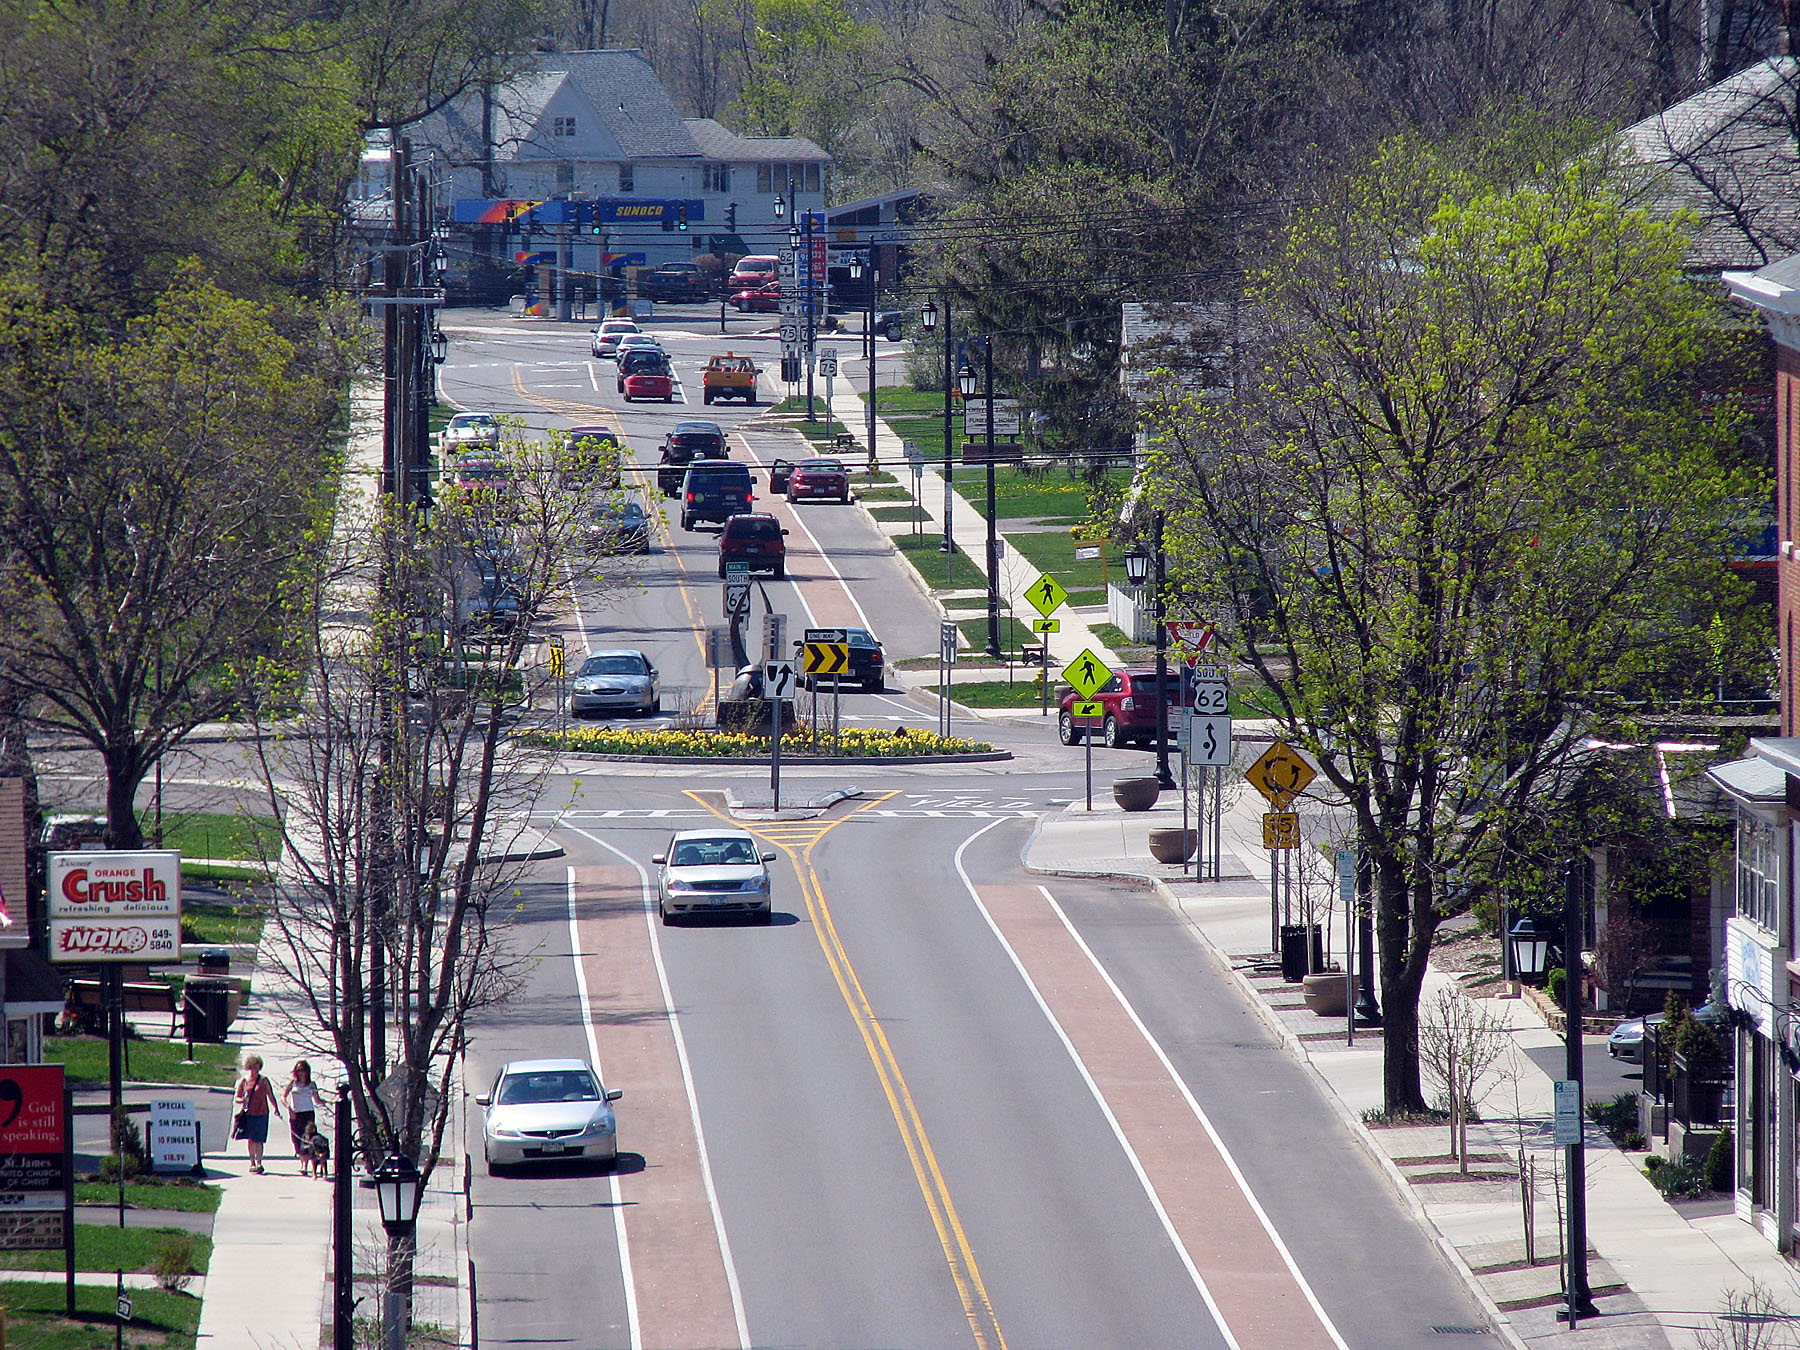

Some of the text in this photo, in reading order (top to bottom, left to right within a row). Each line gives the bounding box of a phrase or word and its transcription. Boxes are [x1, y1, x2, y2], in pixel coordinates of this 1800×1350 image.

[616, 206, 663, 216] SUNOCO
[780, 252, 792, 260] 62
[781, 329, 795, 338] 75
[822, 363, 835, 373] 75
[728, 575, 747, 583] SOUTH
[1198, 690, 1224, 707] 62
[910, 799, 1034, 808] YIELD
[1269, 818, 1292, 833] 15
[95, 869, 136, 877] ORANGE
[62, 868, 166, 903] Crush
[59, 905, 110, 913] refreshing
[123, 903, 169, 911] delicious
[152, 929, 172, 939] 649-
[67, 931, 130, 948] NOW
[150, 941, 172, 950] 5840
[1555, 1083, 1562, 1092] 2
[28, 1101, 55, 1113] God
[18, 1116, 55, 1127] is still
[3, 1130, 59, 1144] speaking,
[22, 1157, 51, 1168] James
